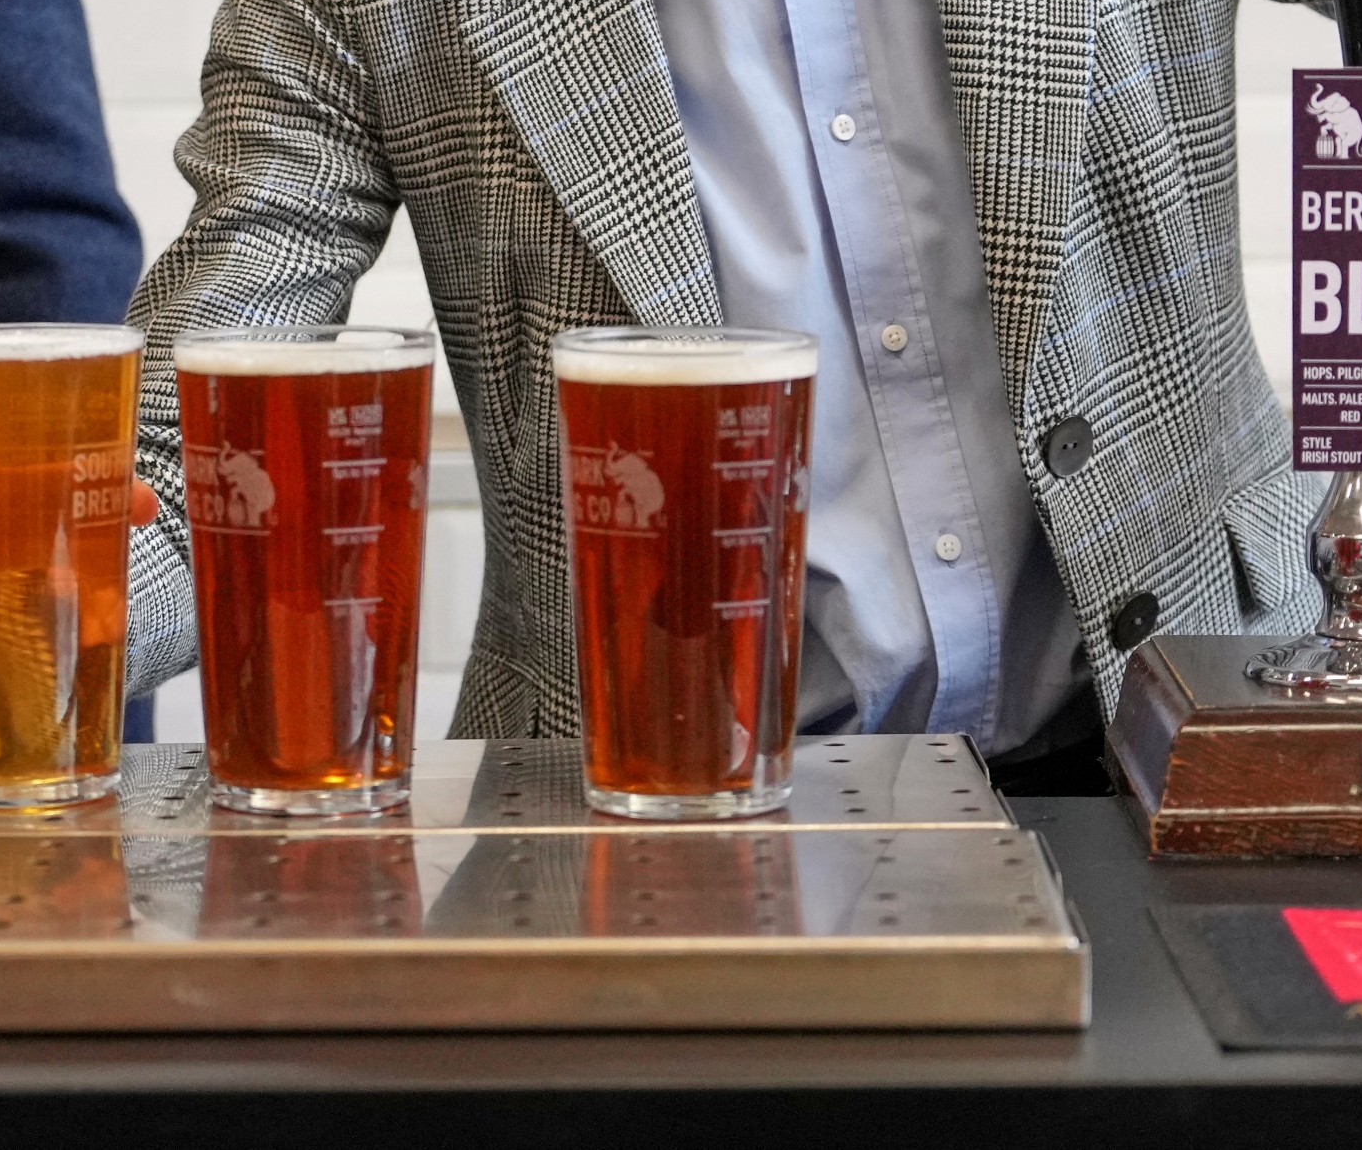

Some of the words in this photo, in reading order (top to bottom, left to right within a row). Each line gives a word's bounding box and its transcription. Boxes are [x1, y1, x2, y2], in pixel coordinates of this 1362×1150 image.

[1303, 366, 1336, 381] HOPS.
[1302, 392, 1338, 406] MALTS.
[1340, 410, 1361, 424] RED
[1302, 436, 1332, 449] STYLE
[1301, 450, 1329, 464] IRISH
[1330, 450, 1362, 464] STOUT
